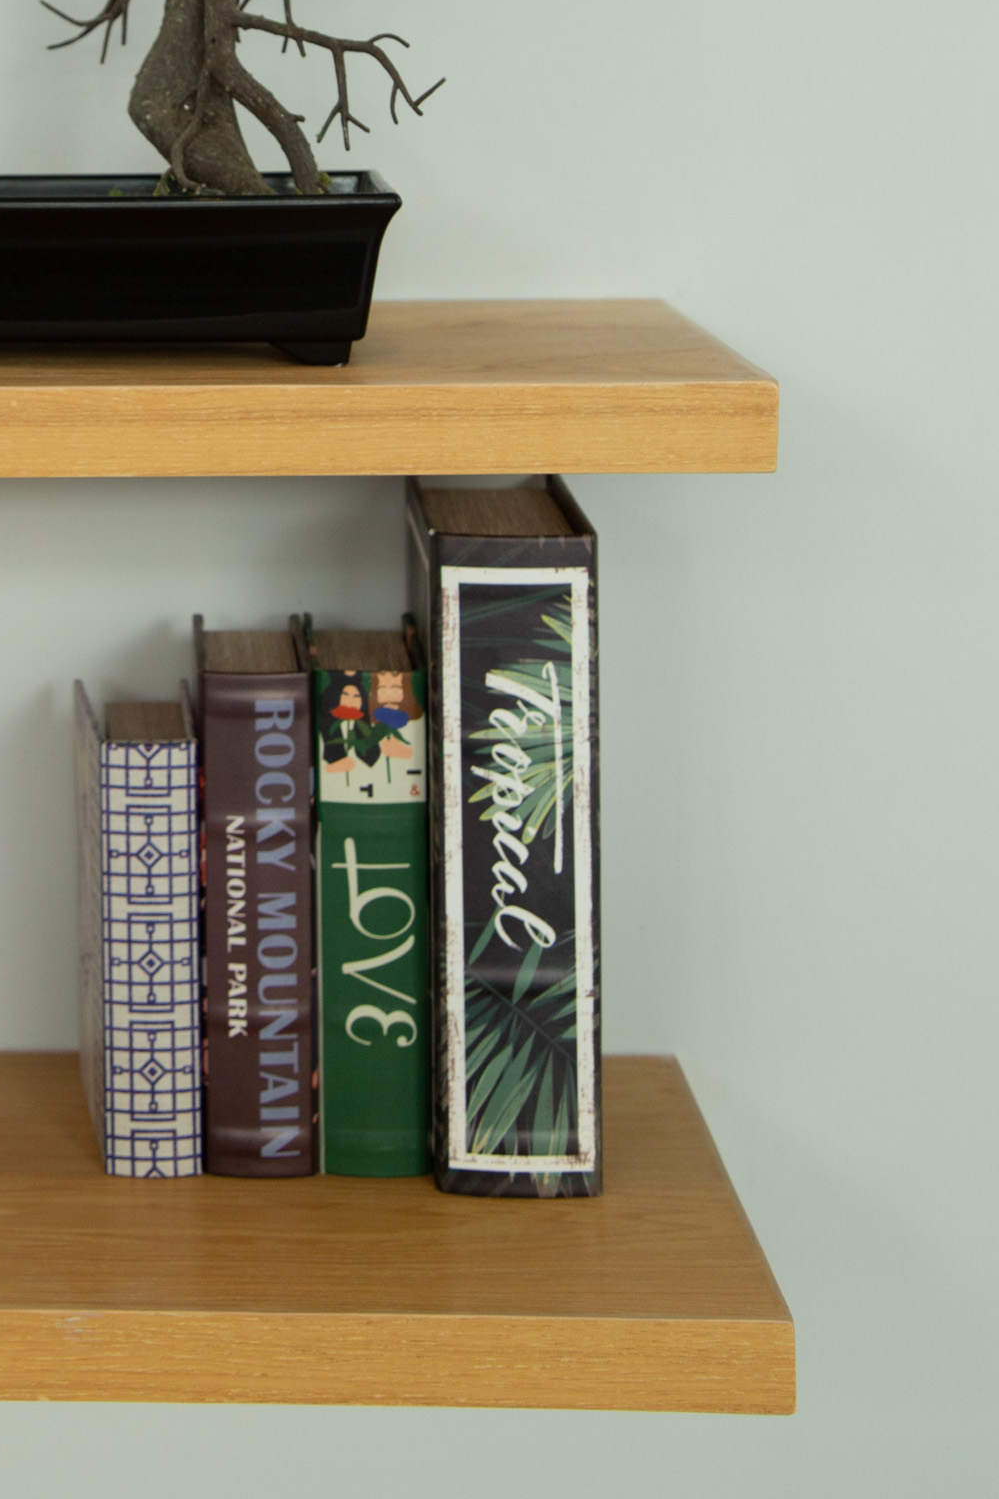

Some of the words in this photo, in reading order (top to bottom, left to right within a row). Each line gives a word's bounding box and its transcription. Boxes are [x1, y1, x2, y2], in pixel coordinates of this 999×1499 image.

[254, 699, 296, 872] ROCKY
[470, 660, 564, 952] Tropical
[226, 815, 248, 953] NATIONAL
[227, 962, 249, 1039] PARK
[257, 892, 300, 1158] MOUNTAIN
